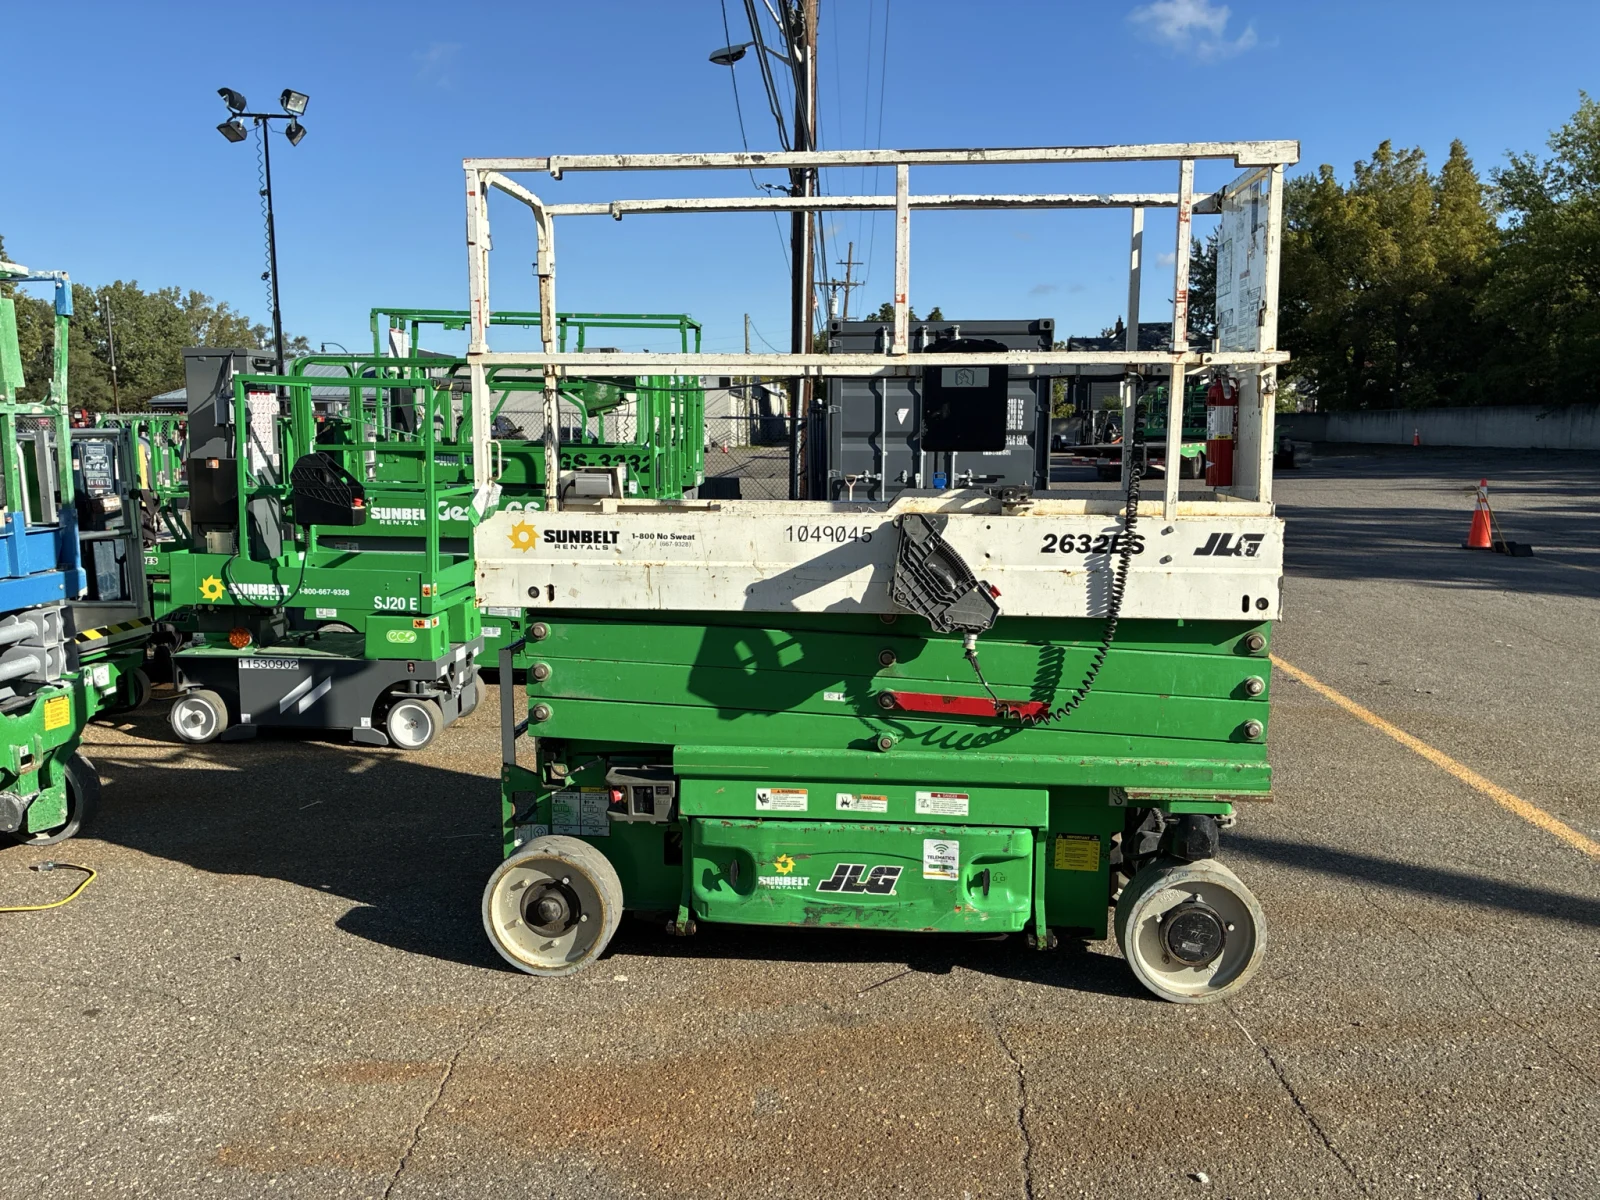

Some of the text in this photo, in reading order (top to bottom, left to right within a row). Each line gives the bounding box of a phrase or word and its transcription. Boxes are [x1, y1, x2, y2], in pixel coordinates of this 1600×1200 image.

[370, 507, 426, 520] SUNBEL
[543, 529, 620, 544] SUNBELT
[631, 532, 695, 541] 1-800 No Sweat
[785, 525, 873, 543] 1049045
[1040, 533, 1146, 555] 2632ES
[1193, 532, 1265, 557] JLG
[228, 583, 290, 596] SUNBELT
[299, 588, 350, 596] 1-800-667-9328
[374, 595, 418, 610] SJ20 E
[239, 659, 298, 669] 11530902
[758, 876, 808, 886] SUNBELT
[816, 863, 904, 895] JLG
